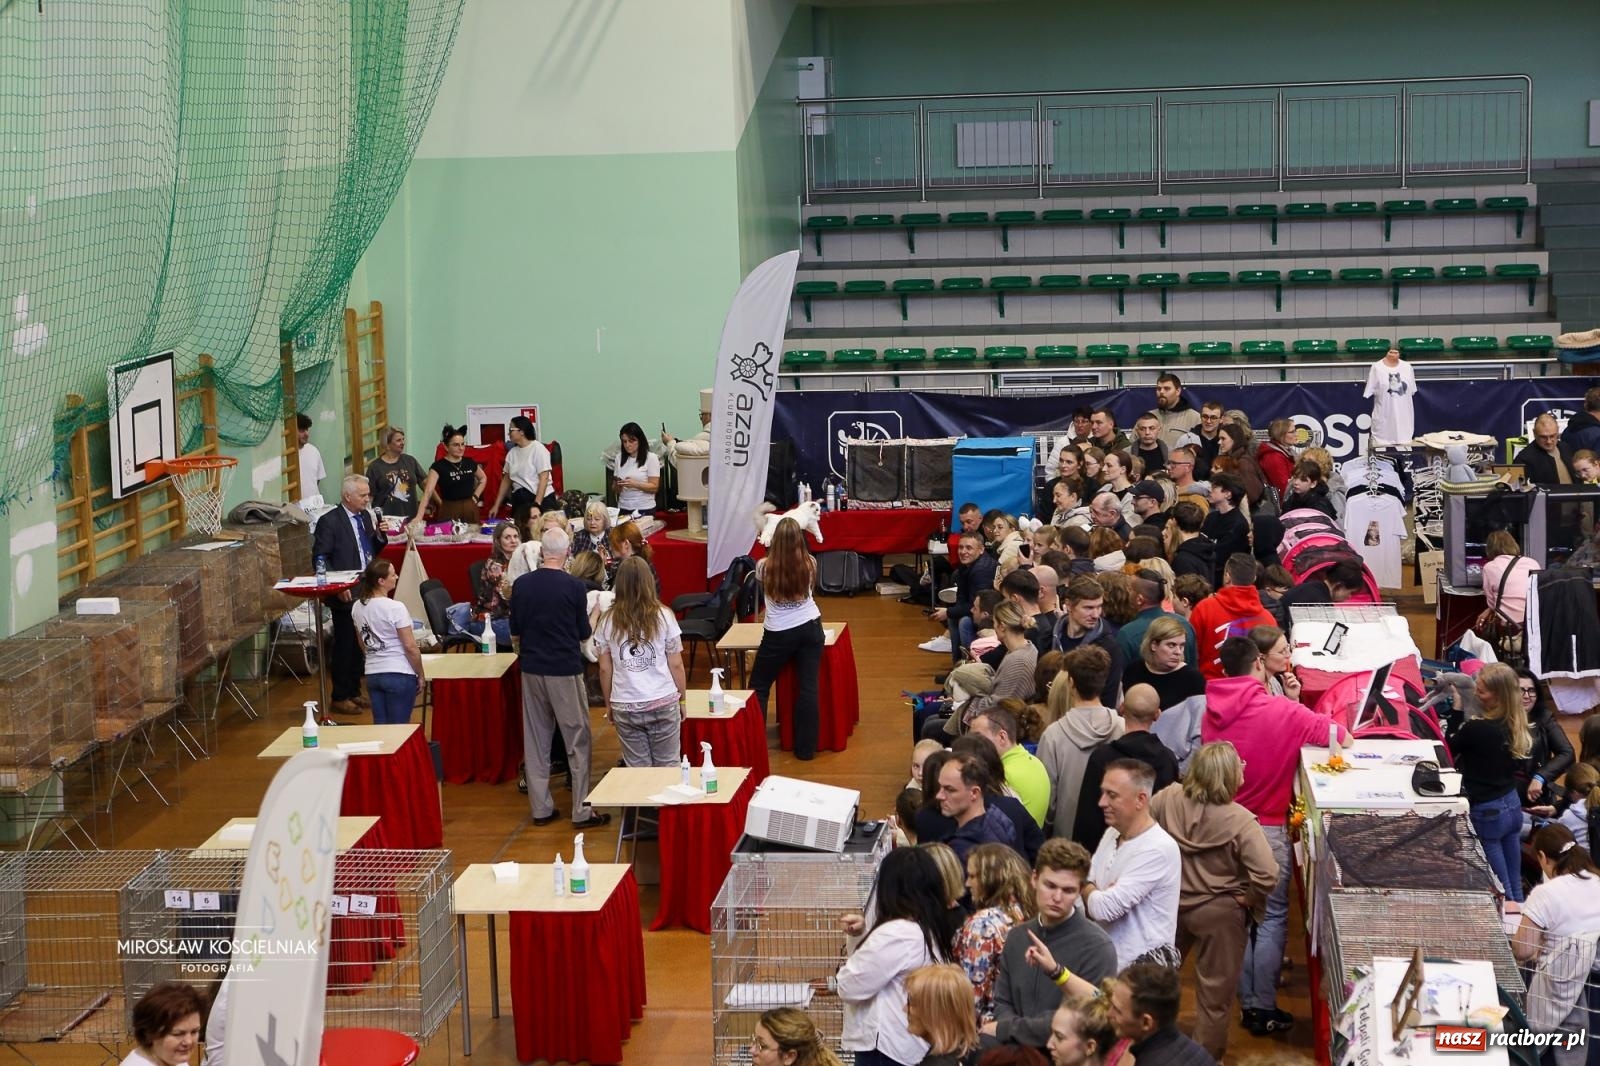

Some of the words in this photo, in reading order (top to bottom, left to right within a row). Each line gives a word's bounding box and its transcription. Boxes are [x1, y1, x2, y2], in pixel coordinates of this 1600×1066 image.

[727, 392, 735, 416] KLUB
[724, 421, 733, 466] HODOWCY
[733, 393, 753, 467] azan
[357, 900, 369, 908] 23
